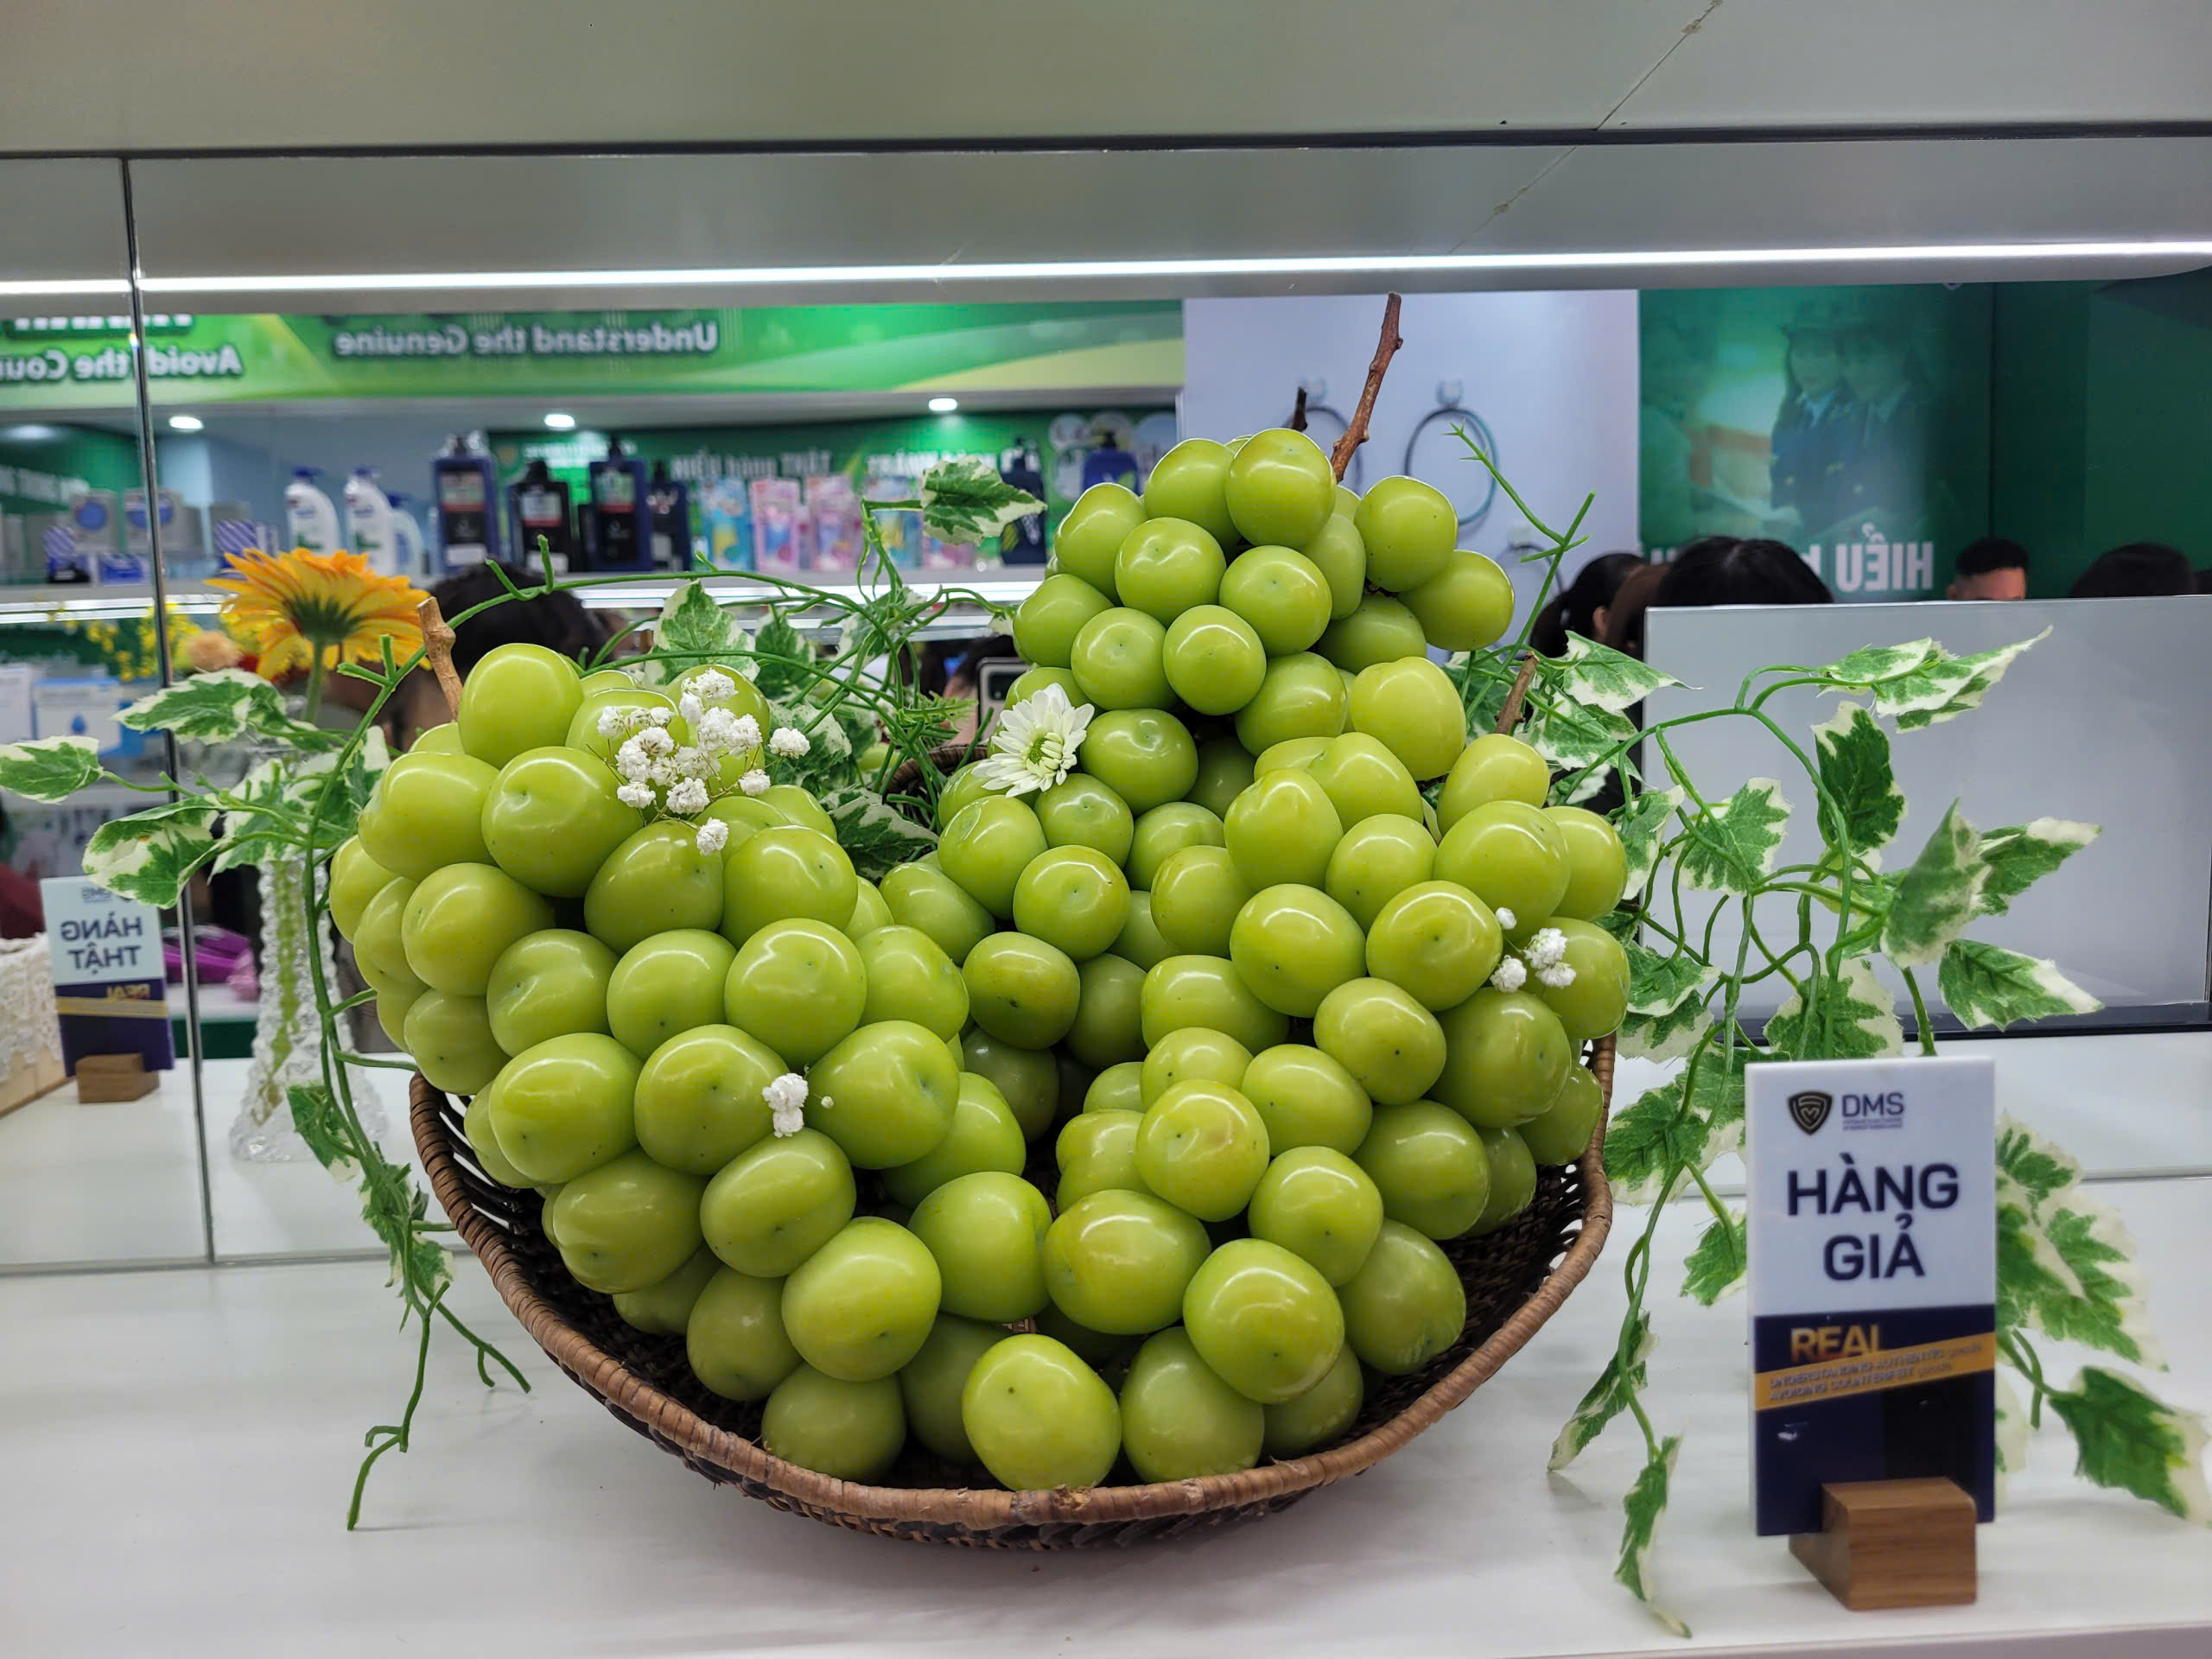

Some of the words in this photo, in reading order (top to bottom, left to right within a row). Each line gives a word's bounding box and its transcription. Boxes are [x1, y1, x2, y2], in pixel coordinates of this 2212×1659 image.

[1841, 1091, 1905, 1117] DMS
[1787, 1151, 1960, 1217] HÀNG
[1823, 1212, 1926, 1281] GIẢ
[1769, 1362, 1873, 1389] UNDERSTANDING
[1875, 1349, 1943, 1369] AUTHENTIC
[1769, 1383, 1827, 1402] AVOIDING
[1830, 1366, 1914, 1391] COUNTERFEIT
